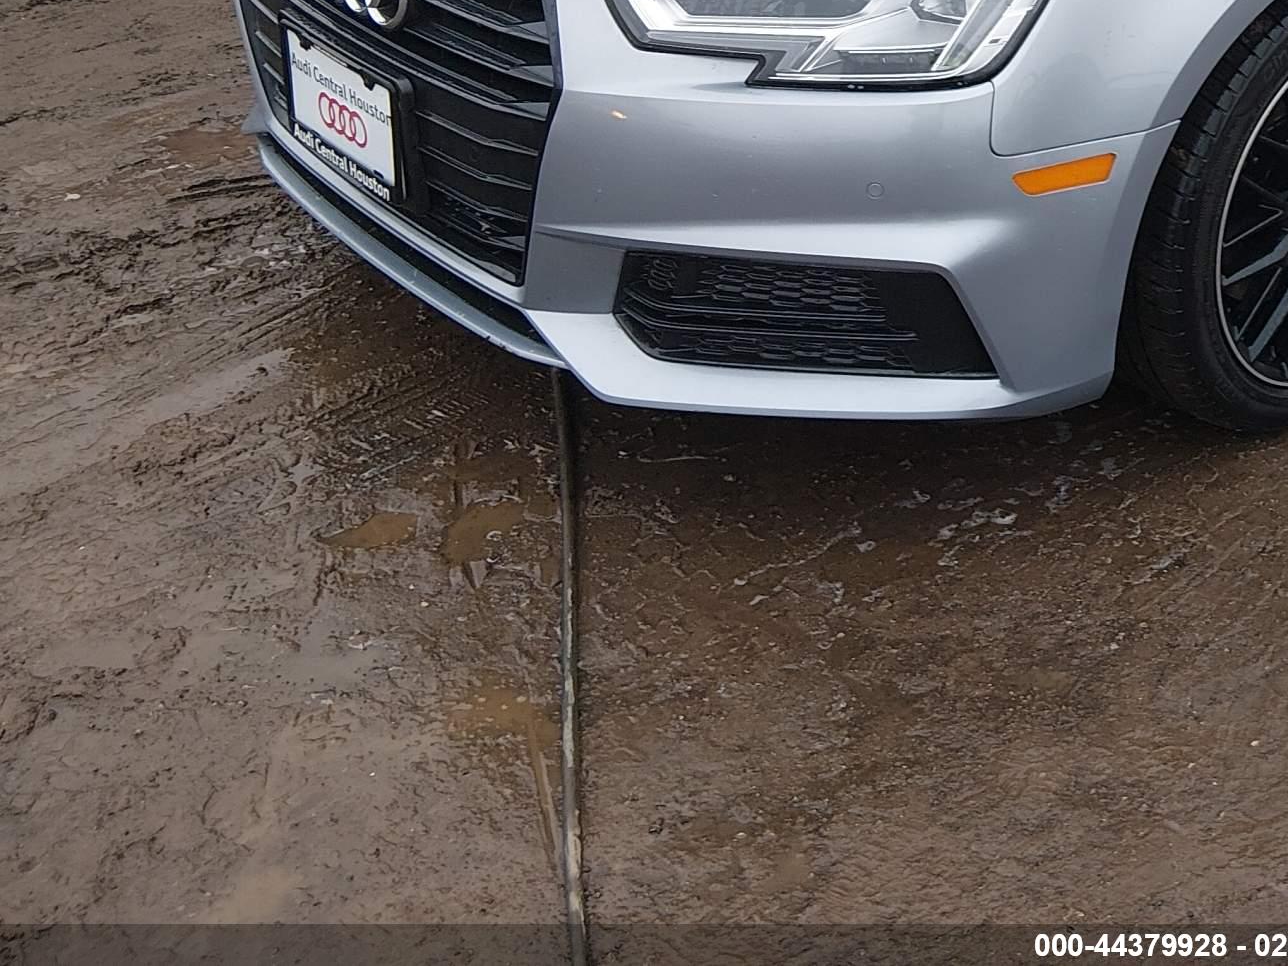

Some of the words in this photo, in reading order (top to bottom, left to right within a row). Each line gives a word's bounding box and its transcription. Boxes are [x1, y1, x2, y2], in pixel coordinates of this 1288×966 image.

[291, 52, 312, 79] Audi
[313, 66, 347, 102] Central
[294, 123, 315, 149] Audi
[314, 139, 348, 173] Central
[349, 160, 391, 202] Houston
